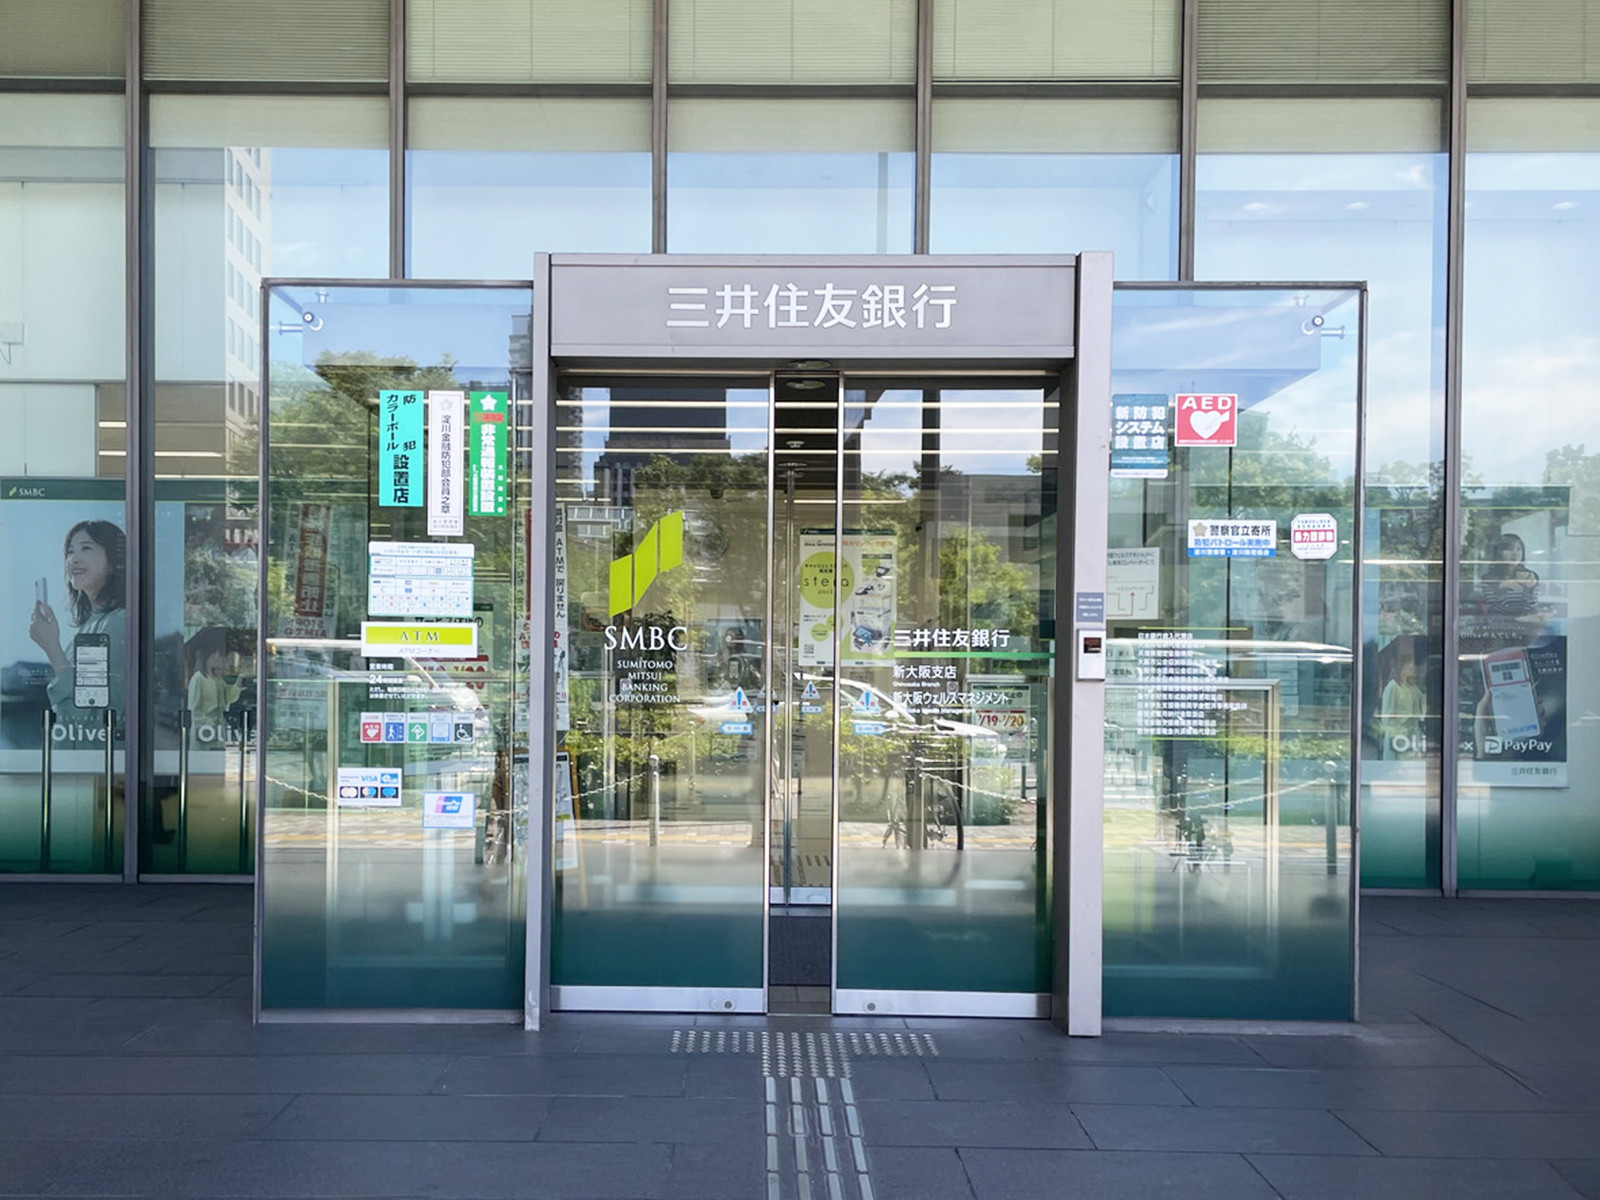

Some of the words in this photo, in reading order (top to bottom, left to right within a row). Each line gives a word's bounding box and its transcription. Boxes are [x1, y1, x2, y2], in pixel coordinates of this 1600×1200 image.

[666, 282, 958, 330] 三井住友銀行
[1181, 396, 1233, 410] AED
[1115, 405, 1166, 420] 新防犯
[386, 393, 400, 452] カラーボール
[1115, 420, 1166, 435] システム
[1115, 435, 1165, 450] 設置店
[393, 454, 410, 504] 設置店
[19, 488, 45, 496] SMBC
[1209, 524, 1272, 537] 警察官立寄所
[400, 630, 440, 642] ATM
[604, 625, 688, 651] SMBC
[893, 628, 1010, 648] 三井住友銀行
[399, 647, 440, 655] ATMコーナー
[616, 657, 674, 669] SUMITOMO
[627, 671, 663, 681] MITSUI
[892, 665, 957, 679] 新大阪支店
[620, 682, 669, 692] BANKING
[609, 693, 681, 703] CORPORATION
[892, 691, 1010, 705] 新大阪ウェルスマネジメント
[52, 723, 107, 742] Olive
[1504, 738, 1553, 752] PayPay
[1511, 767, 1558, 776] 三井住友銀行
[360, 775, 379, 783] VISA
